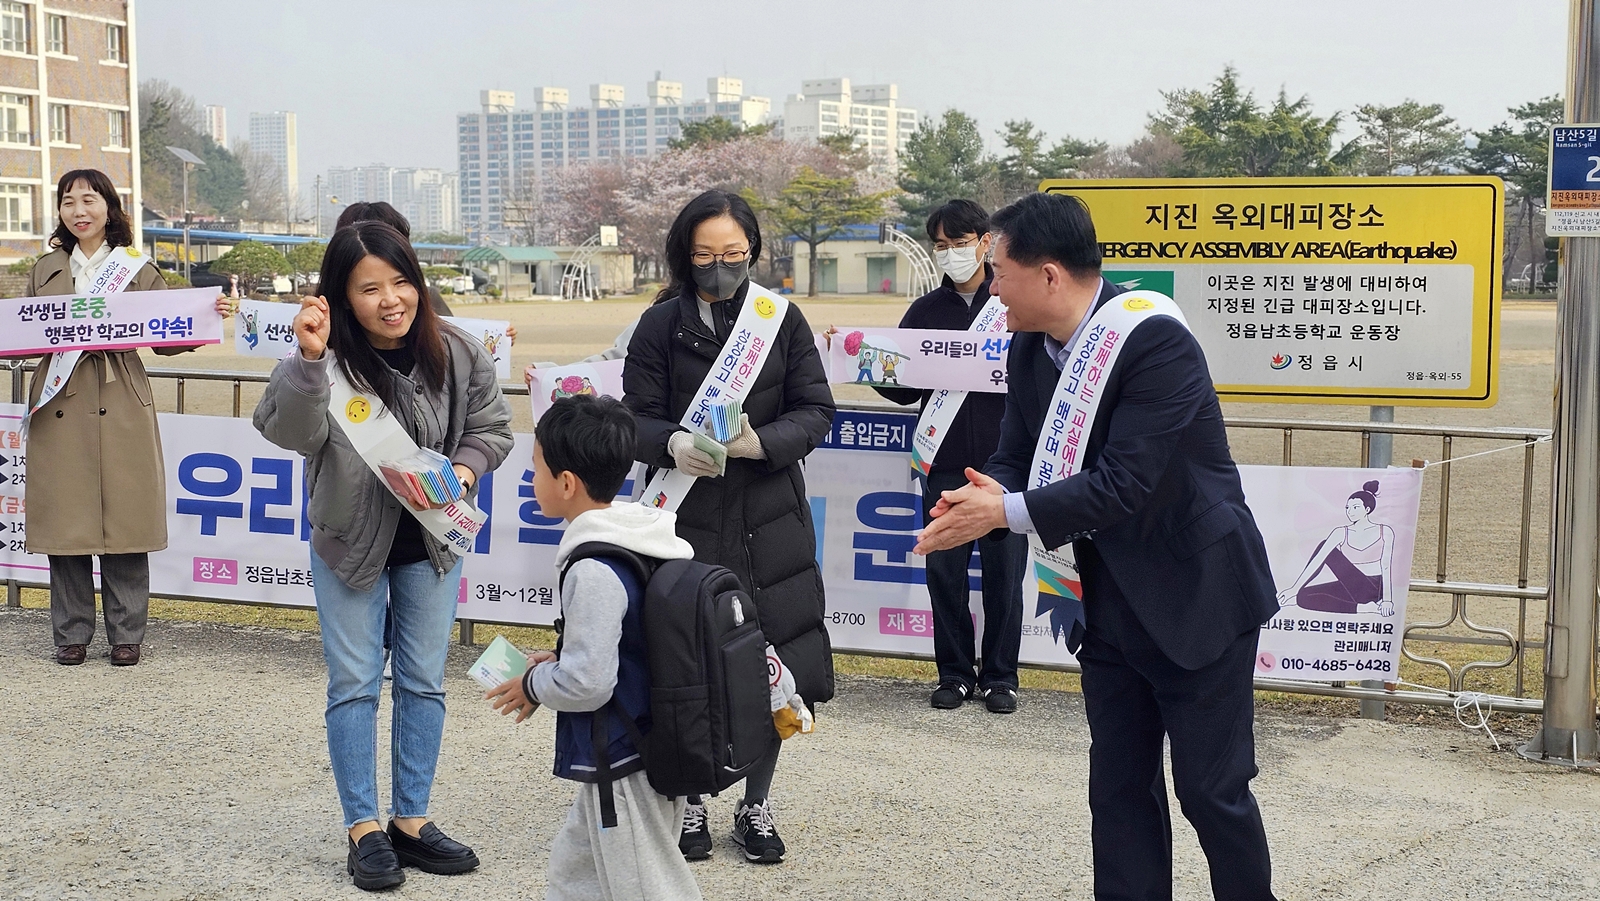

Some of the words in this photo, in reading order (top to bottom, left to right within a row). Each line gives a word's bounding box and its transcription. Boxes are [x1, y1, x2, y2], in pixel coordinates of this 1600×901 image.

[1555, 129, 1597, 142] 남산5길
[1145, 203, 1198, 230] 지진
[1212, 203, 1385, 230] 옥외대피장소
[1189, 242, 1290, 258] ASSEMBLY
[1290, 240, 1457, 263] AREA(Earthquake)
[104, 266, 131, 294] 함께하
[1207, 275, 1256, 292] 이곳은
[1262, 275, 1295, 292] 지진
[1303, 275, 1352, 292] 발생에
[1360, 275, 1427, 292] 대비하여
[18, 301, 66, 322] 선생님
[70, 296, 111, 320] 존중,
[1207, 298, 1255, 314] 지정된
[1263, 298, 1295, 314] 긴급
[1303, 298, 1427, 315] 대피장소입니다.
[44, 325, 94, 345] 행복한
[96, 322, 144, 341] 학교의
[148, 316, 193, 338] 약속!
[989, 311, 1007, 332] 함께
[1226, 323, 1342, 341] 정읍남초등학교
[1350, 325, 1400, 341] 운동장
[715, 328, 751, 383] 성장하고
[919, 339, 978, 358] 우리들의
[981, 338, 1013, 361] 선
[1063, 323, 1106, 395] 성장하고
[730, 336, 765, 392] 함께하는
[1080, 329, 1120, 404] 함께하는
[1406, 371, 1462, 381] 정읍-옥외-55
[690, 384, 721, 427] 배우며
[839, 420, 907, 448] 출입금지
[1045, 400, 1071, 457] 배우며
[1057, 408, 1087, 479] 교실에서
[176, 452, 309, 542] 우리
[199, 562, 233, 580] 장소
[475, 583, 553, 605] 3월~12월
[886, 612, 933, 632] 재정
[1297, 619, 1333, 633] 있으면
[1335, 621, 1394, 635] 연락주세요
[1334, 640, 1391, 653] 관리매니저
[1281, 657, 1391, 672] 010-4685-6428
